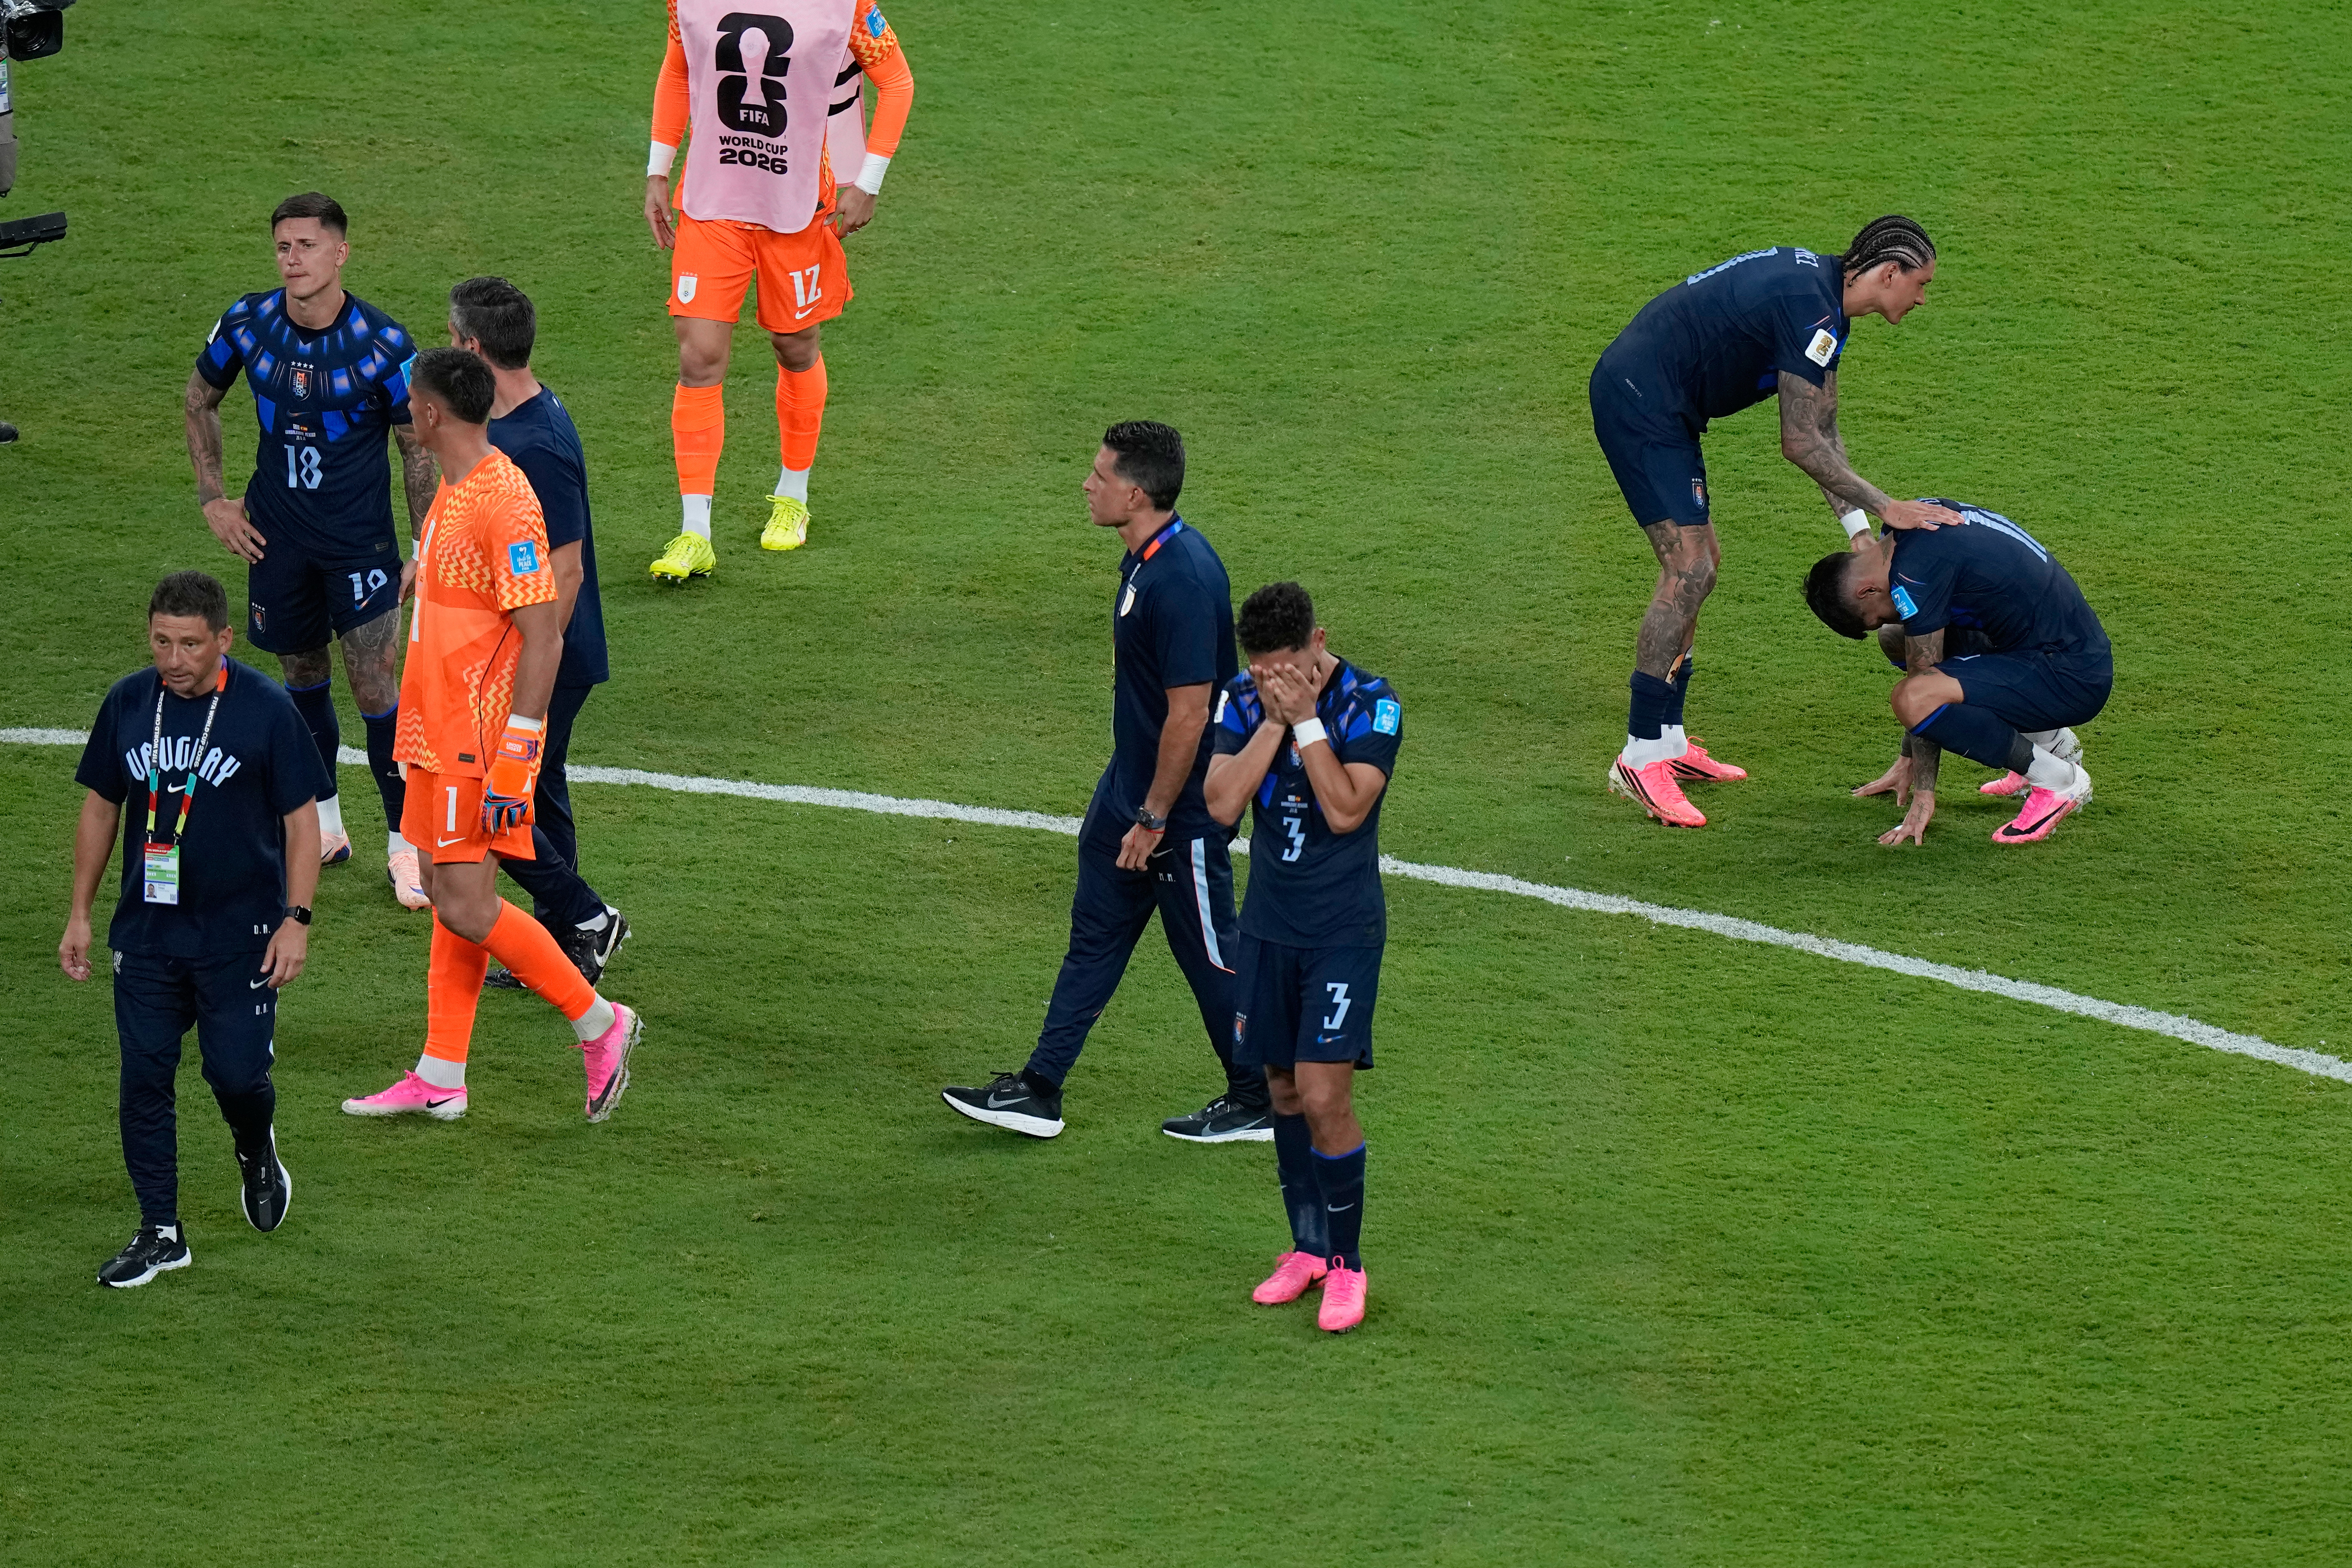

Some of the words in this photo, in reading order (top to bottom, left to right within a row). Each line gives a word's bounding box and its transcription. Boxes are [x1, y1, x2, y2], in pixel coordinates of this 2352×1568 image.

[739, 110, 770, 126] FIFA
[719, 136, 764, 149] WORLD
[765, 143, 788, 155] CUP
[719, 148, 787, 174] 2026
[789, 263, 822, 307] 12
[284, 444, 323, 489] 18
[210, 696, 219, 710] FIFA
[204, 709, 216, 732] WORLD
[194, 744, 204, 767] 2026
[446, 786, 458, 831] 1
[1282, 816, 1306, 862] 3
[1324, 982, 1351, 1029] 3
